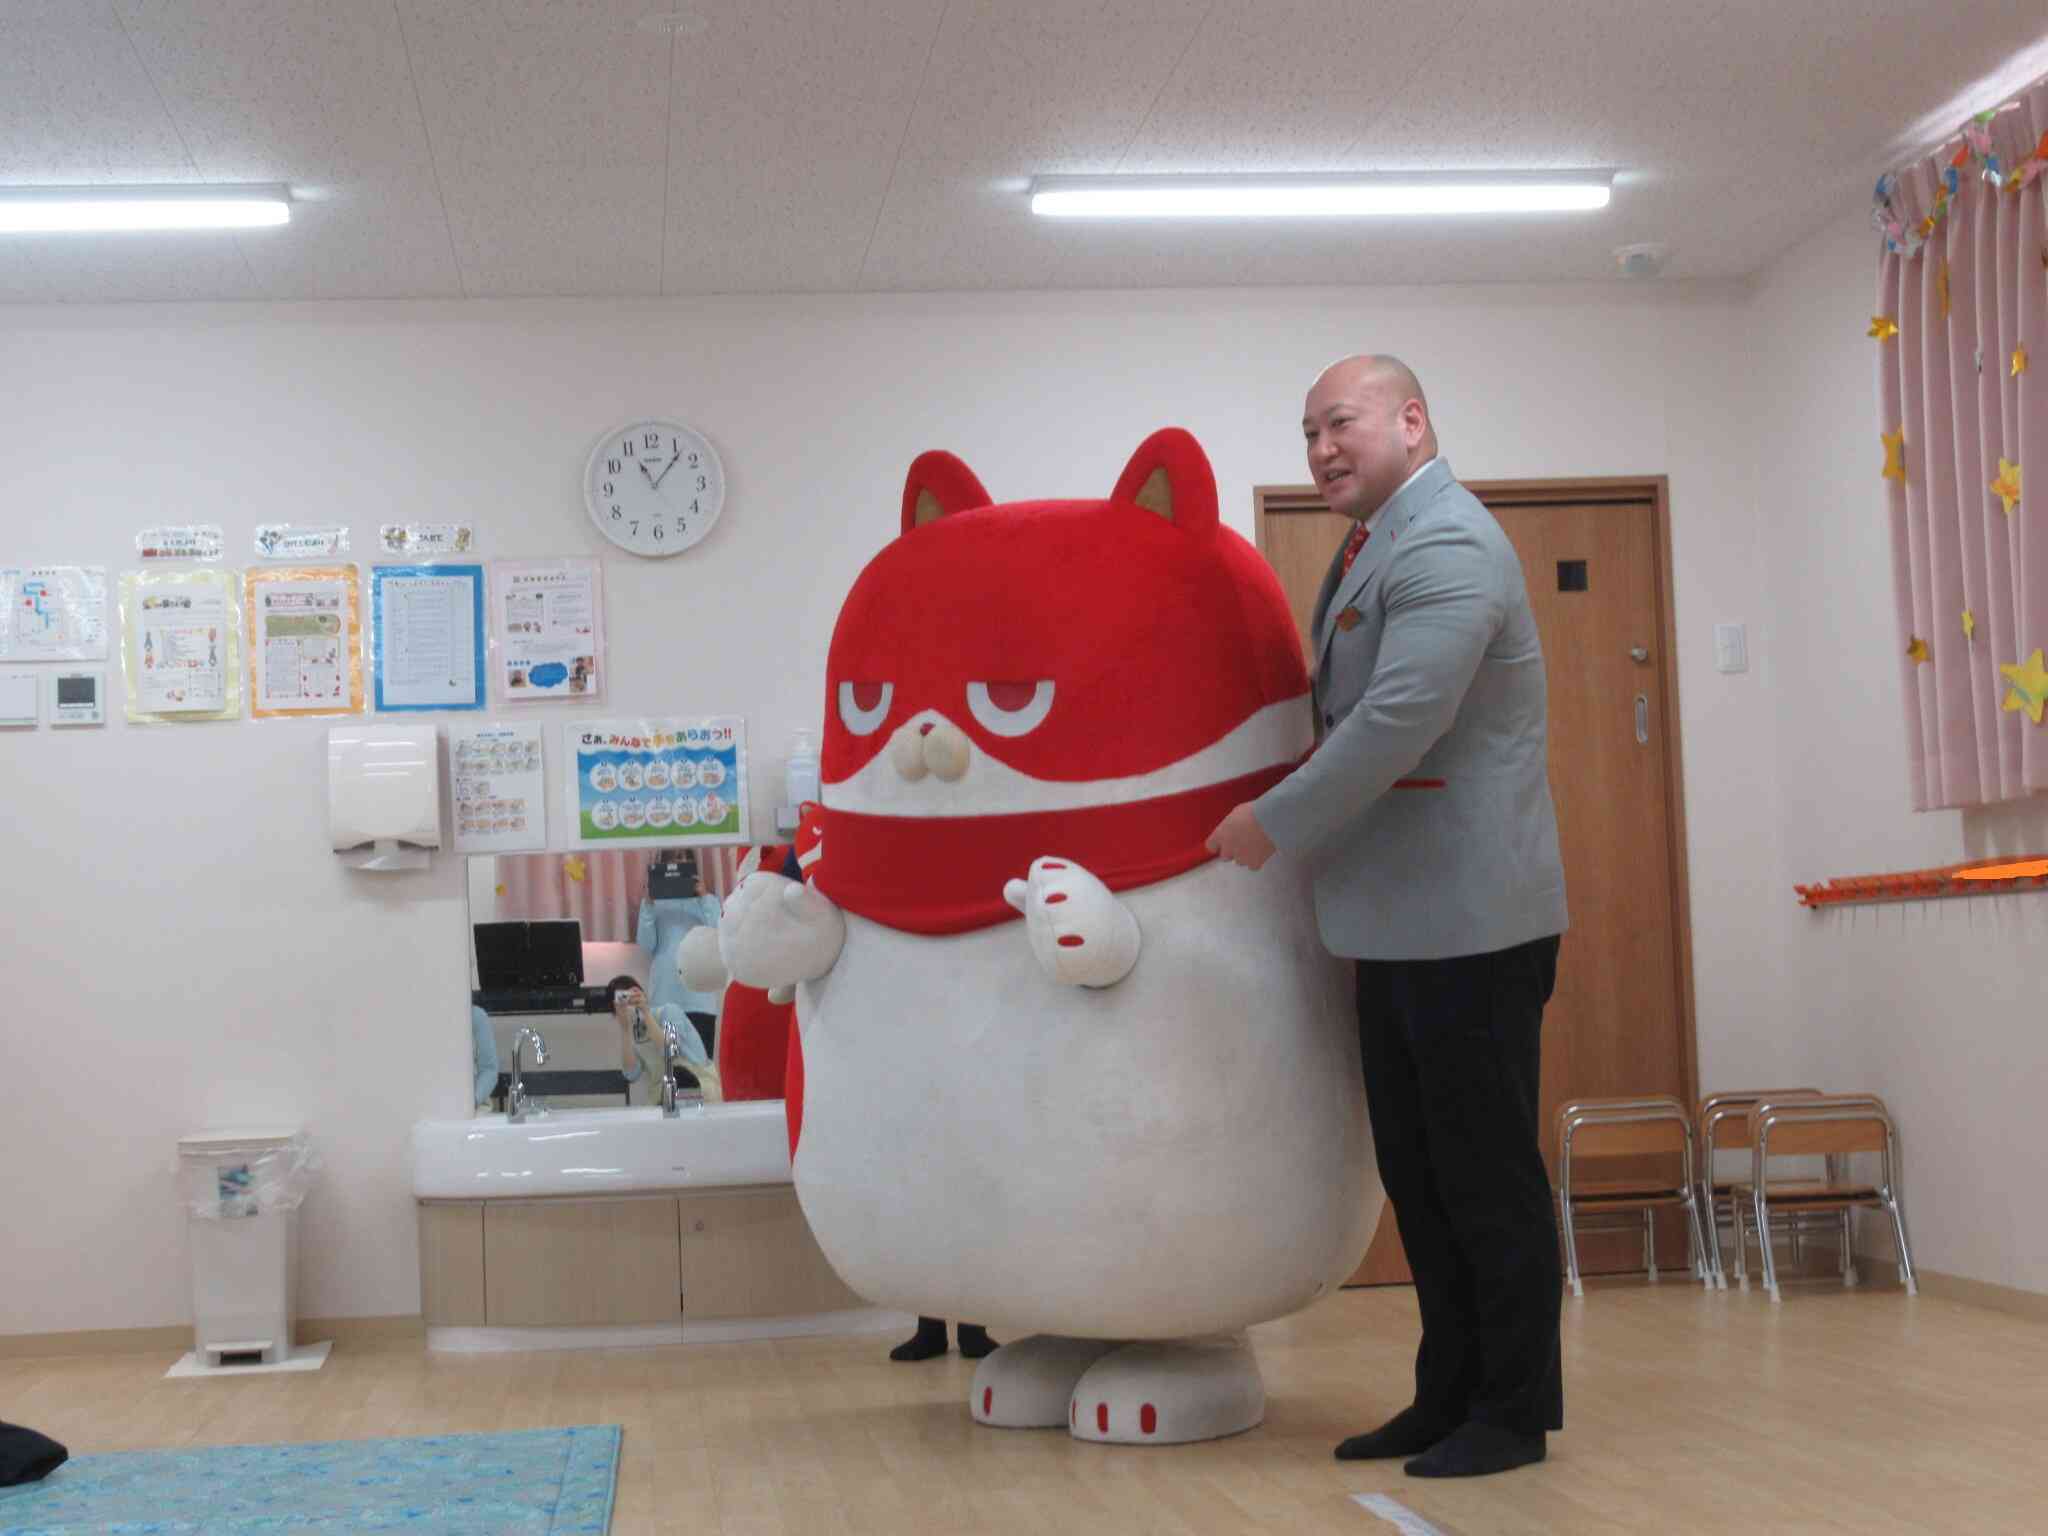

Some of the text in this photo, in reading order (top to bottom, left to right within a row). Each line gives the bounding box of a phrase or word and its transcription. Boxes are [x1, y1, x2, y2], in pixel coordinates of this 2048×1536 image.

[623, 440, 634, 457] 11
[644, 433, 659, 449] 12
[672, 437, 678, 453] 1
[608, 459, 621, 475] 10
[688, 454, 698, 469] 2
[603, 482, 614, 497] 9
[695, 475, 706, 492] 3
[611, 504, 622, 521] 8
[689, 499, 699, 514] 4
[629, 520, 639, 536] 7
[653, 524, 664, 541] 6
[676, 517, 687, 534] 5
